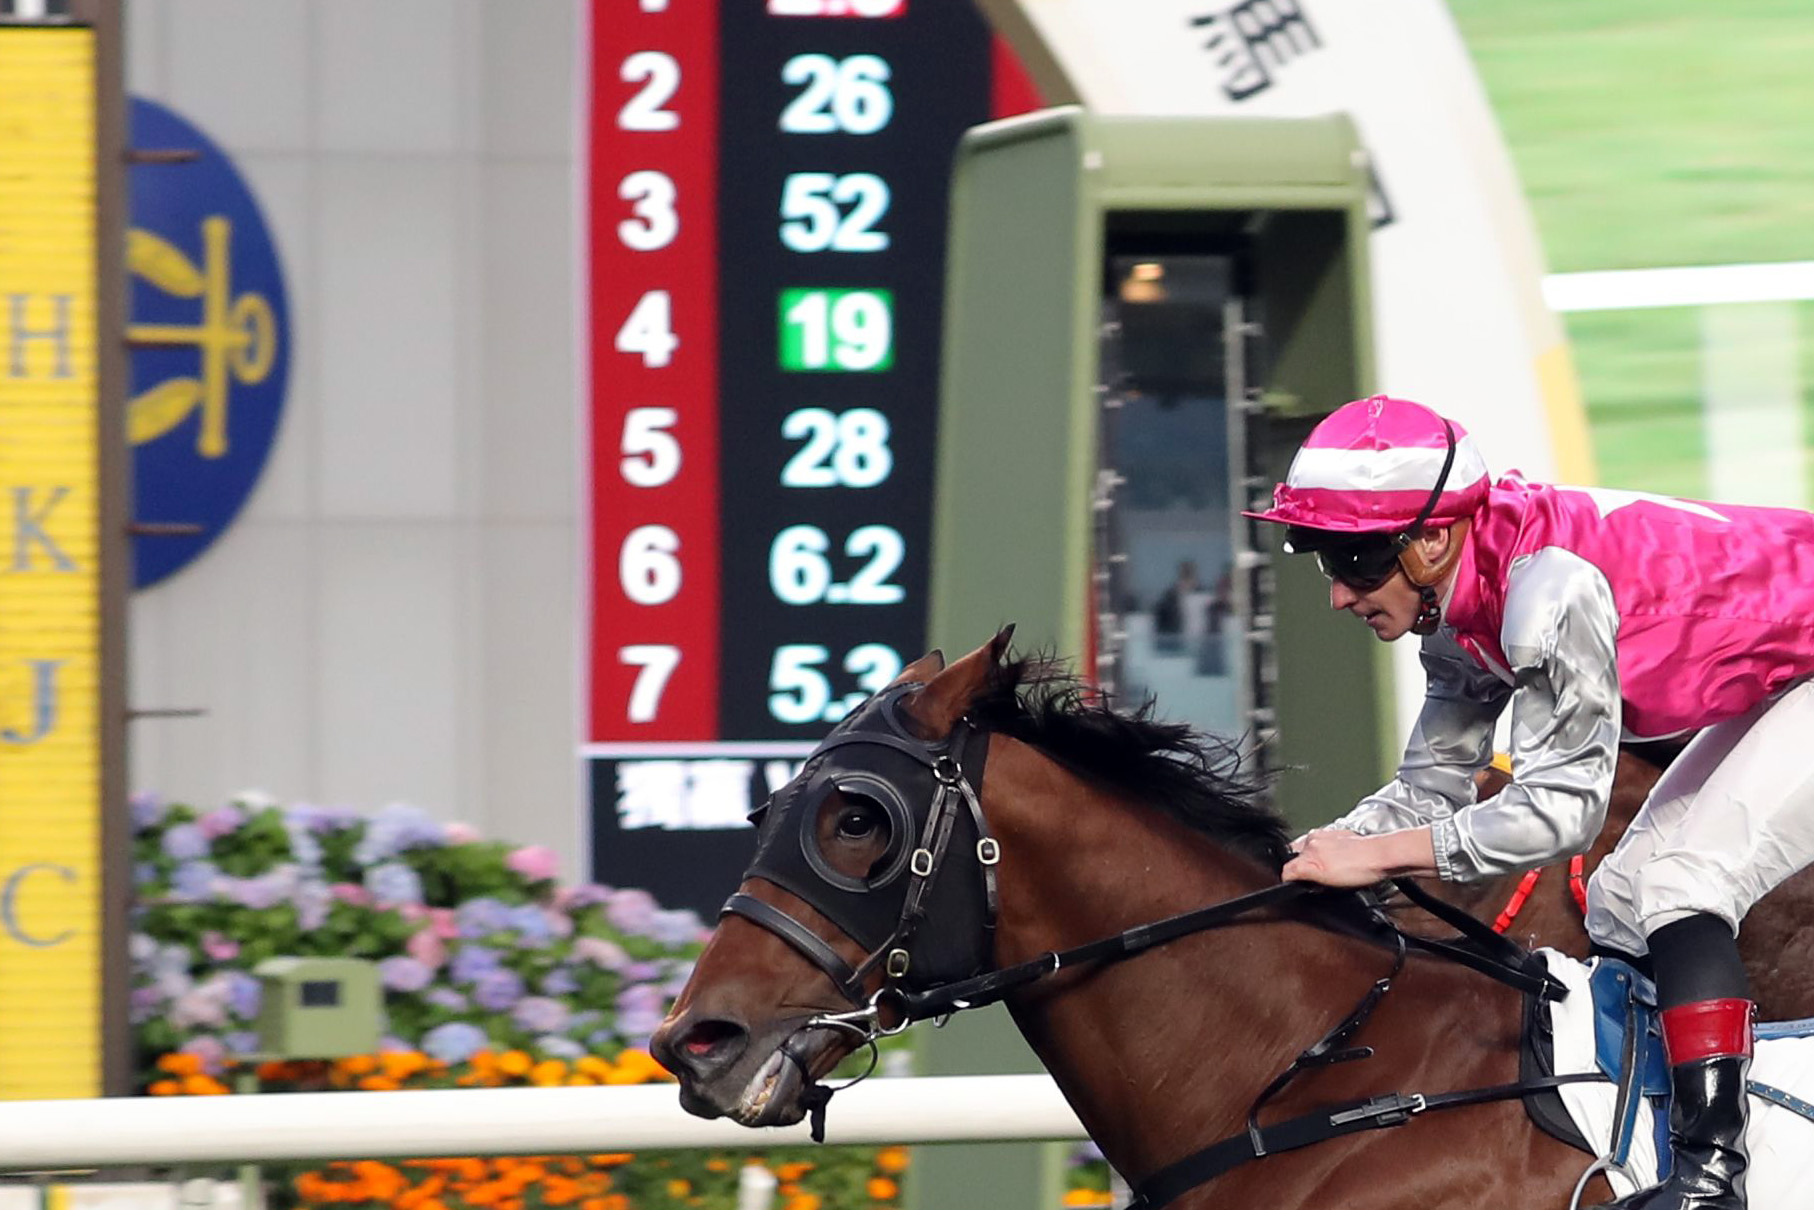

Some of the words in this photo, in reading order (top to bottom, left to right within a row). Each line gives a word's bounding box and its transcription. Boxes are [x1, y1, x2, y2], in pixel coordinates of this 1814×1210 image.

[616, 50, 683, 131] 2
[779, 53, 895, 135] 26
[617, 170, 680, 251] 3
[779, 172, 892, 253] 52
[614, 289, 681, 369] 4
[785, 290, 893, 371] 19
[619, 406, 683, 488] 5
[779, 407, 895, 488] 28
[618, 524, 683, 606] 6
[768, 524, 907, 606] 6.2
[617, 644, 683, 724] 7
[768, 643, 903, 724] 5.3
